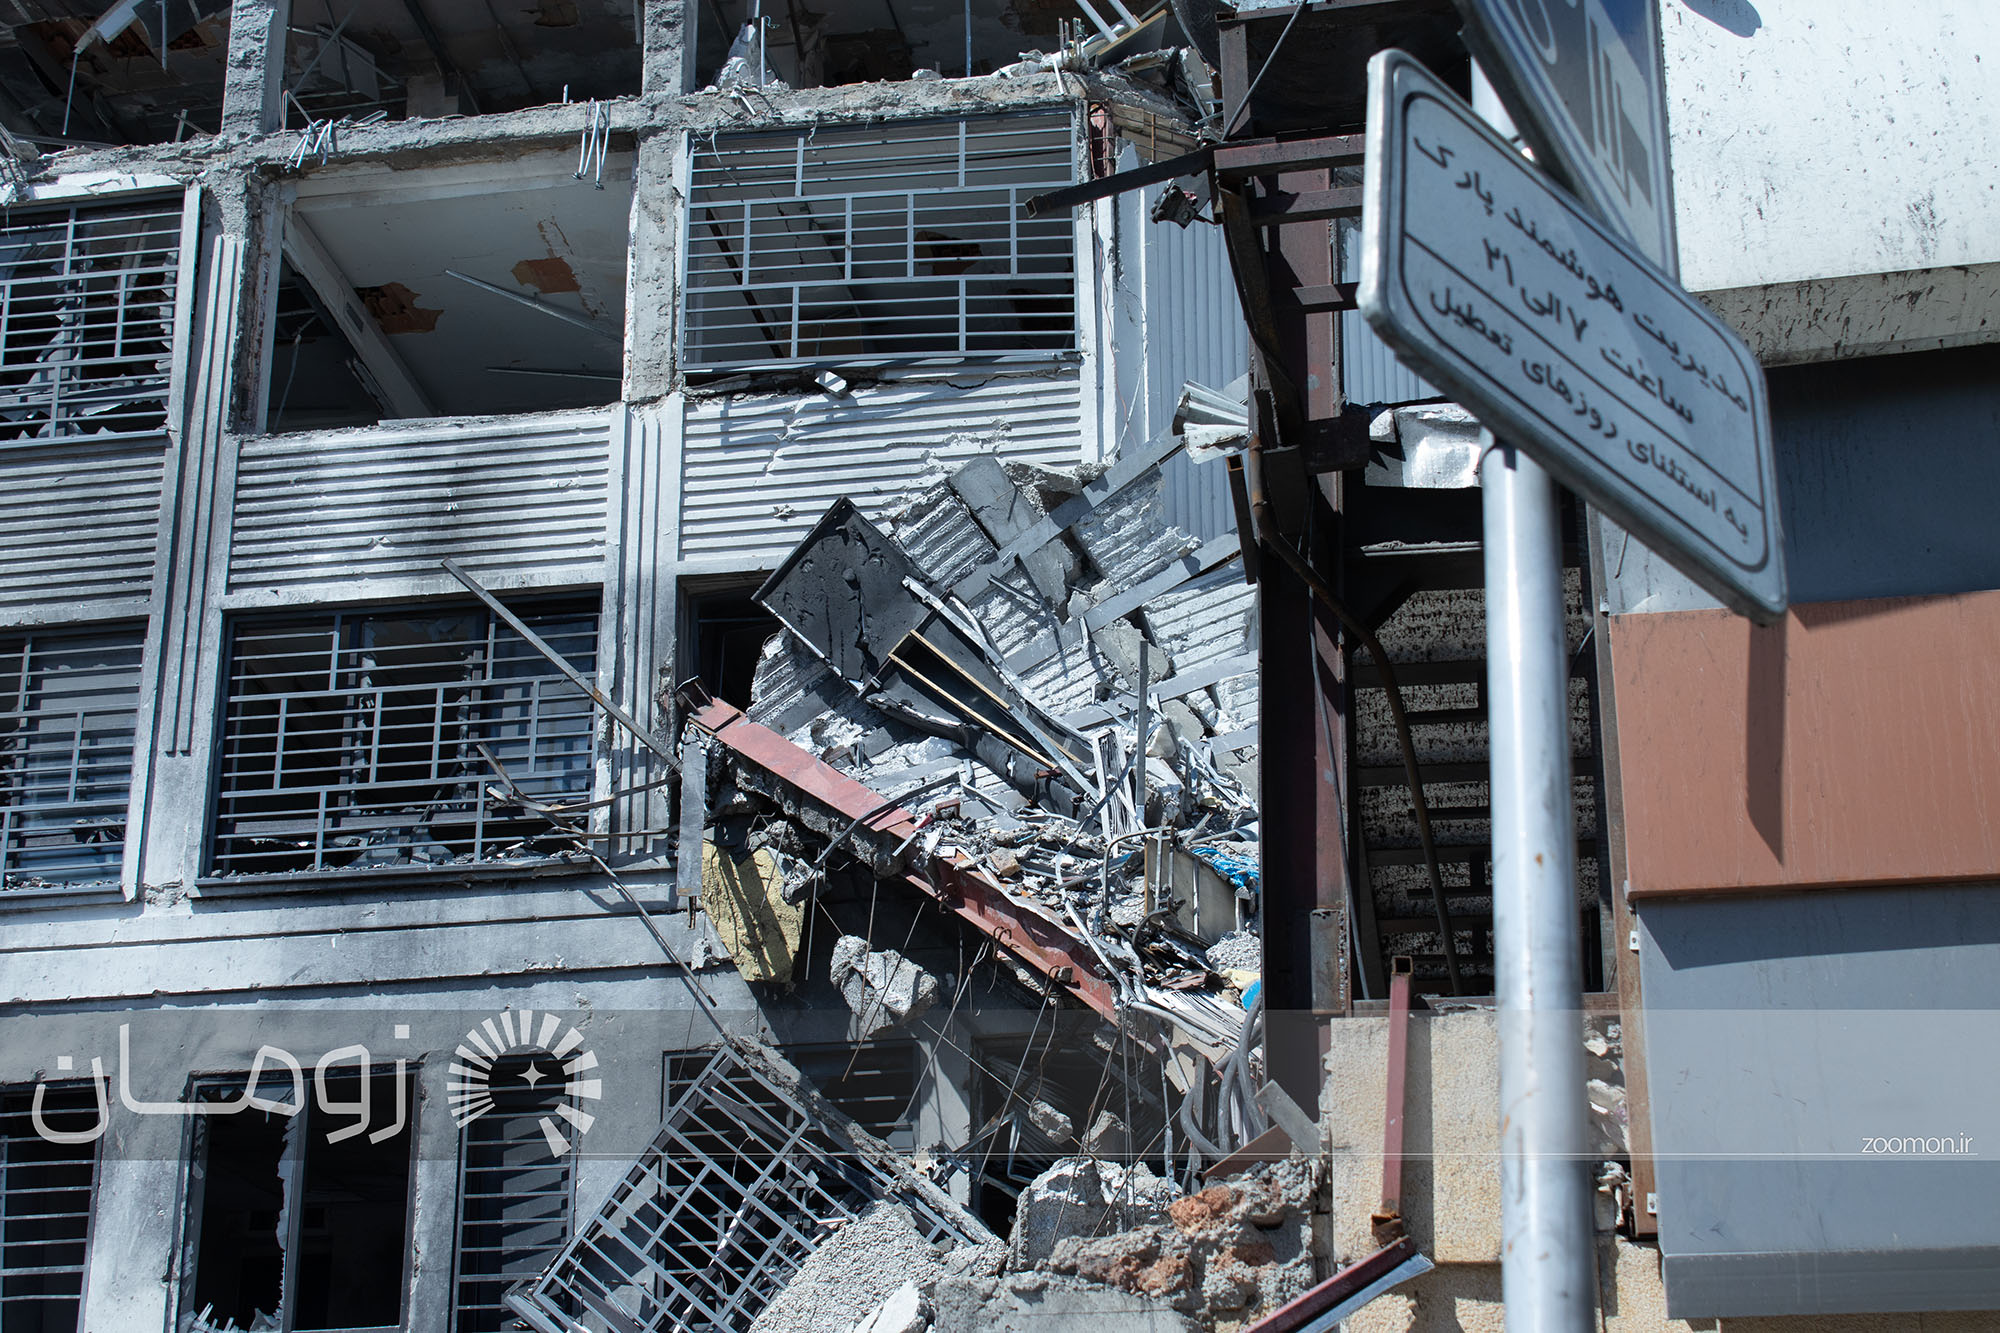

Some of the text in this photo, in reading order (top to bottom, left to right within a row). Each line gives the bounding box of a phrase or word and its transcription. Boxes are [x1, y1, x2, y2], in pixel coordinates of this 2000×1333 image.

[1413, 136, 1749, 413] مدیریت هوشمند پارک
[1482, 237, 1515, 288] ۲۱
[1520, 286, 1562, 325] الی
[1565, 305, 1589, 343] ۷
[1429, 286, 1749, 545] به استثنای روزهای تعطیل
